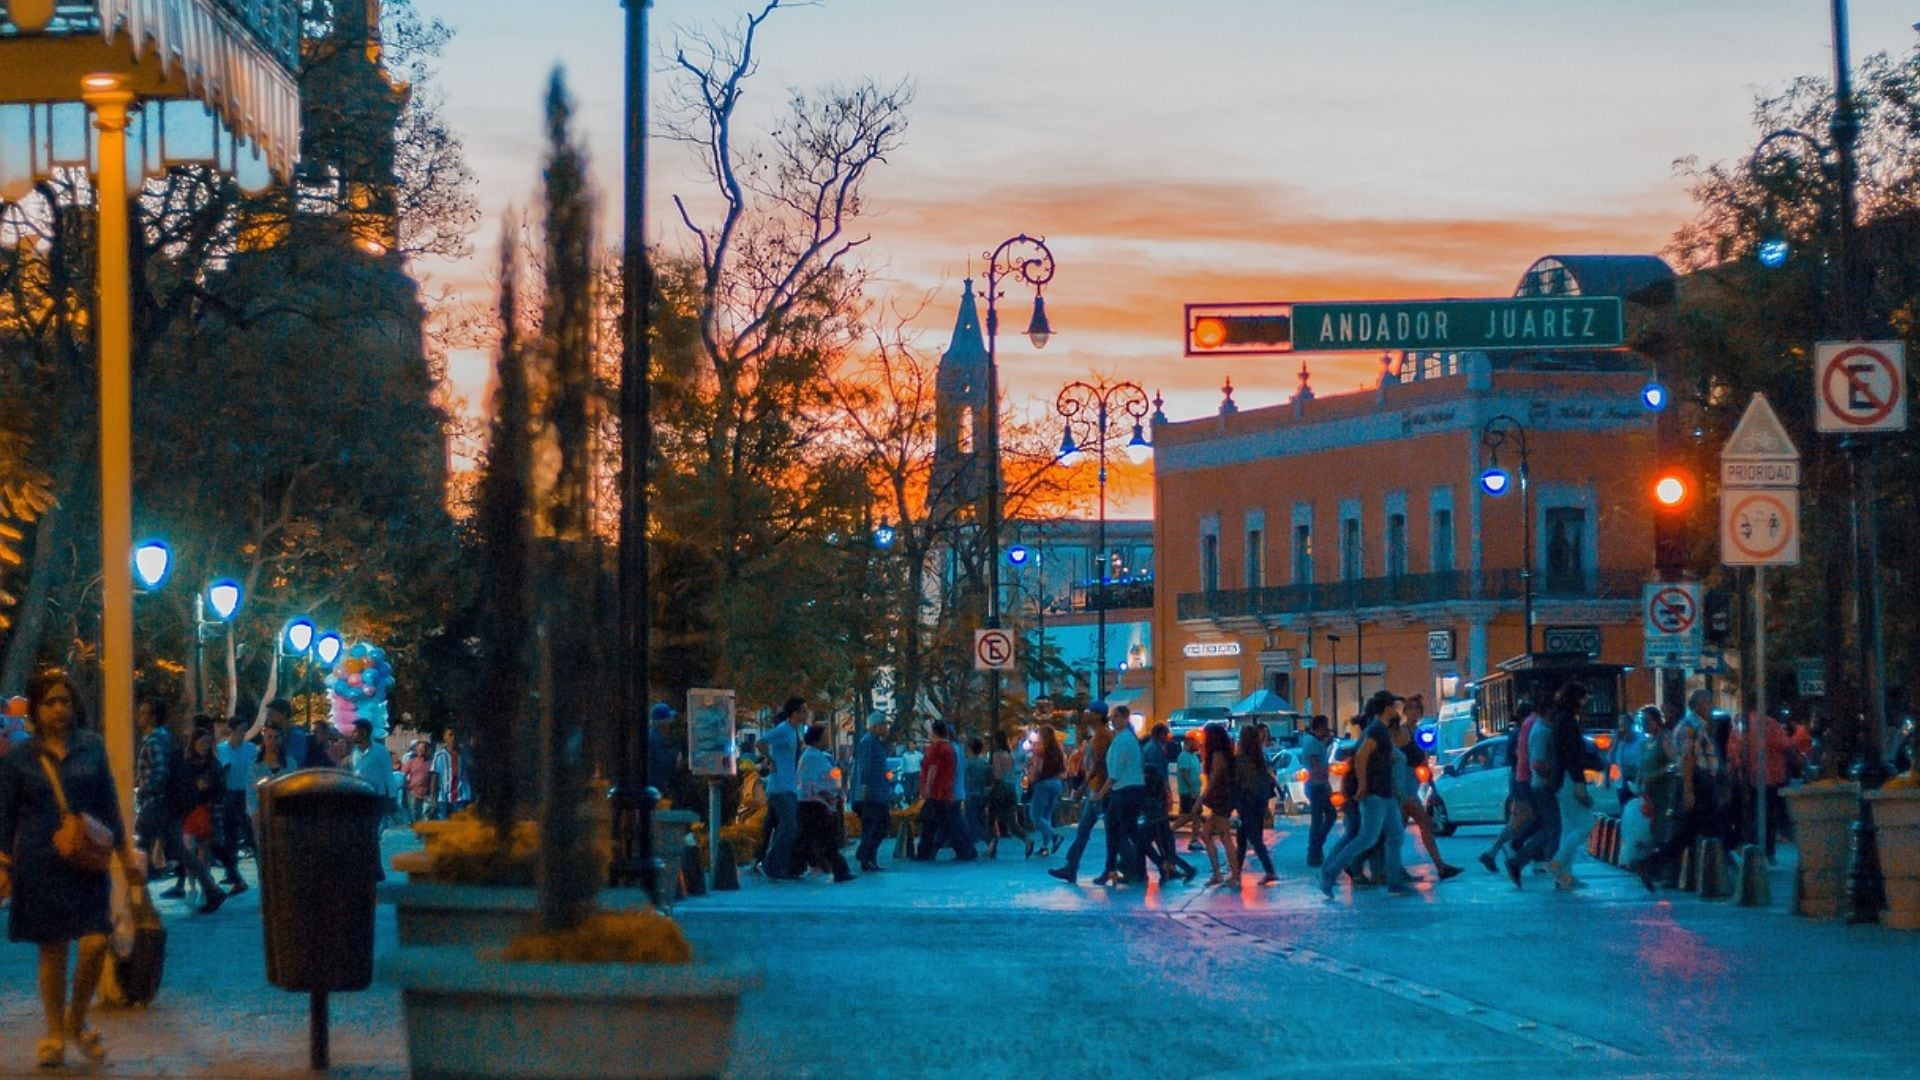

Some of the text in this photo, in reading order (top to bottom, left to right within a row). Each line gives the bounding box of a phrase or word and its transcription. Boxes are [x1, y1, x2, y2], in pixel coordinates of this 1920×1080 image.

[1320, 308, 1595, 342] ANDADOR JUAREZ
[1728, 465, 1792, 481] PRIORIDAD
[1550, 635, 1597, 651] OXXO
